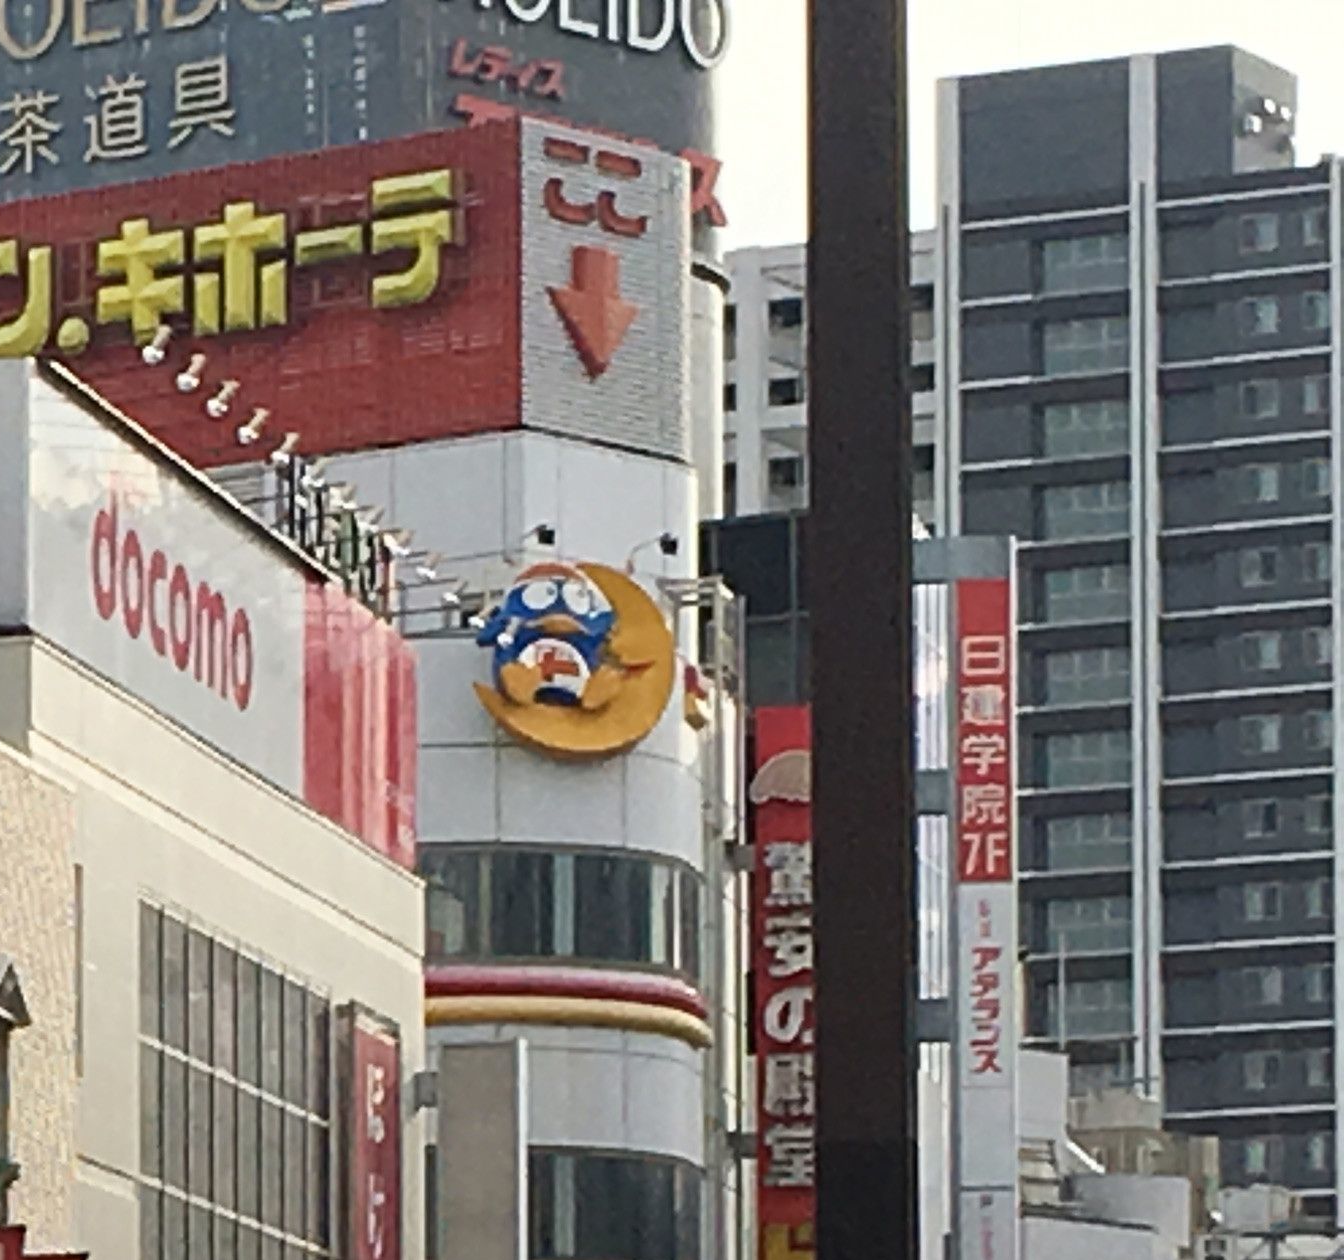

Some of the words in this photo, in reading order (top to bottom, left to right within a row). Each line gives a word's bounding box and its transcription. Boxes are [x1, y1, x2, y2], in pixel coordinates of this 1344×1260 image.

[542, 136, 648, 239] ここ
[88, 490, 254, 712] docomo
[962, 831, 1008, 876] 7F
